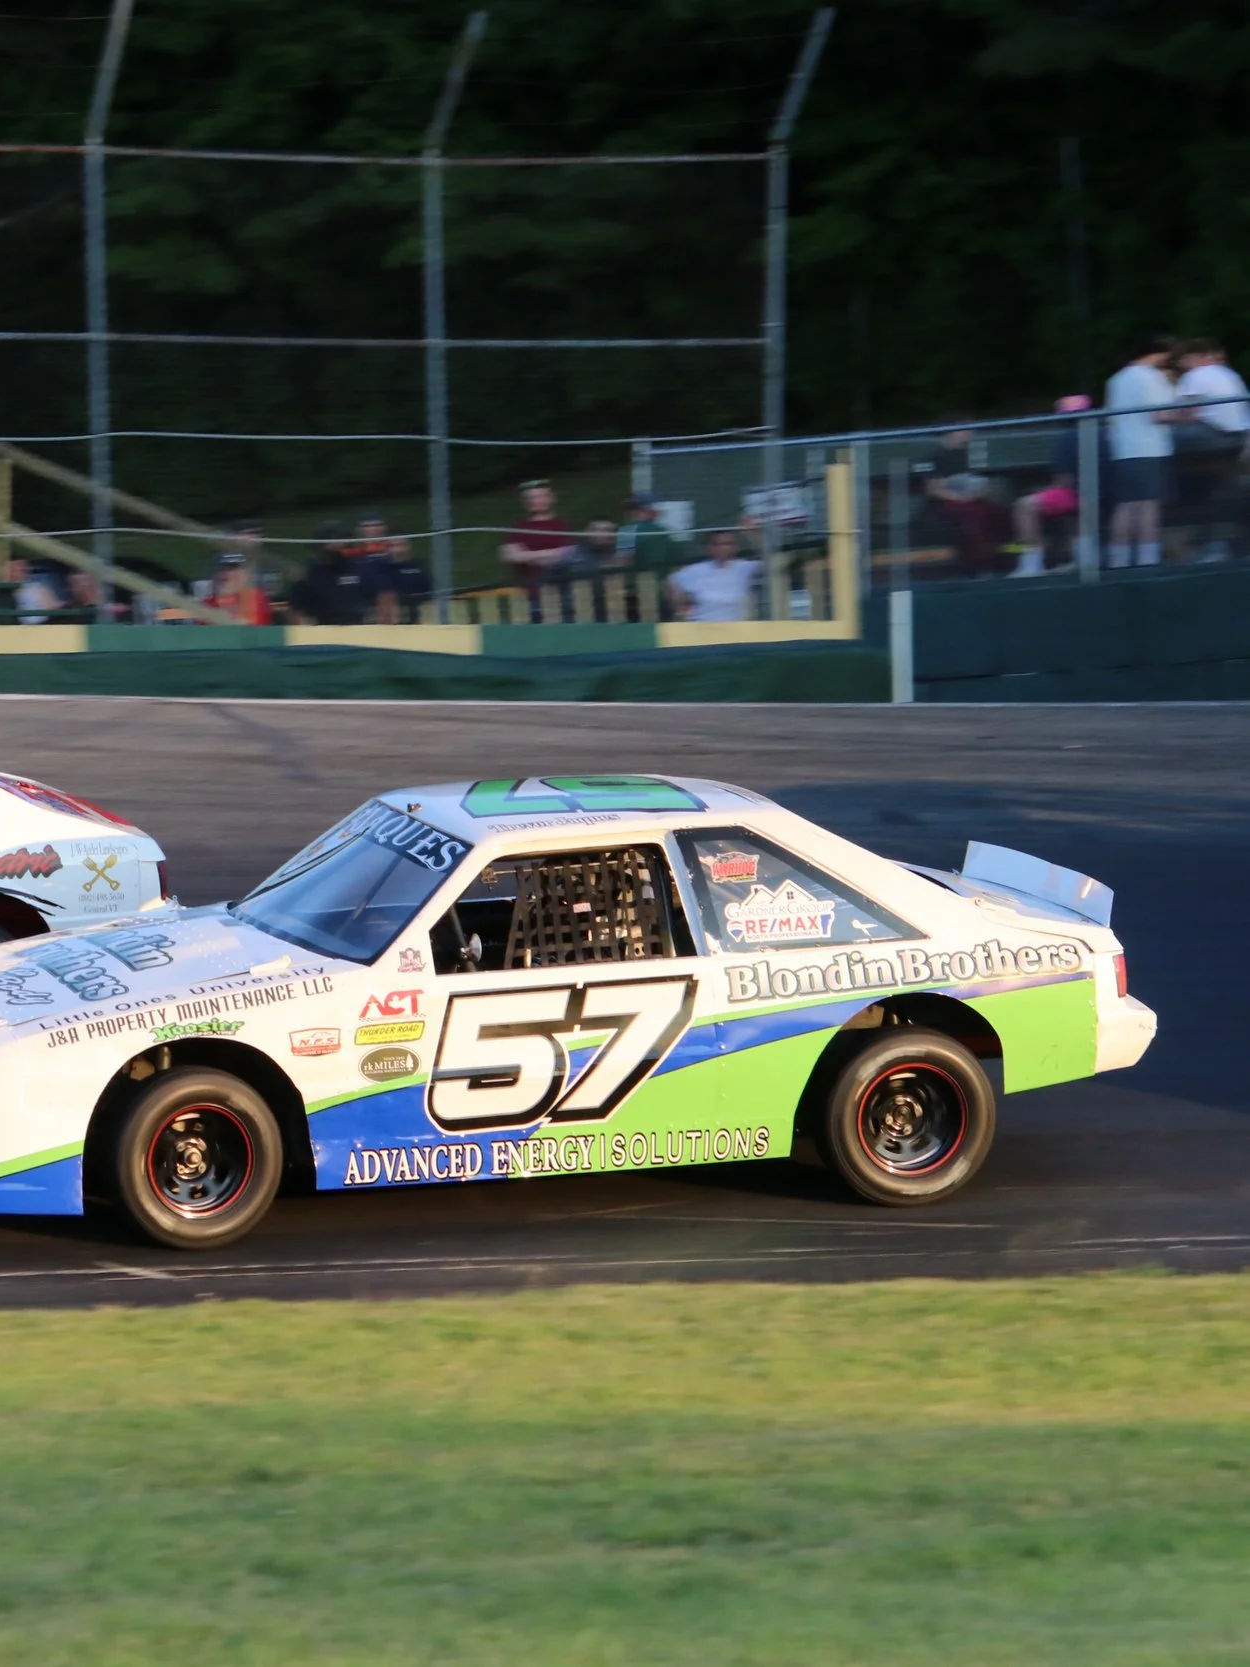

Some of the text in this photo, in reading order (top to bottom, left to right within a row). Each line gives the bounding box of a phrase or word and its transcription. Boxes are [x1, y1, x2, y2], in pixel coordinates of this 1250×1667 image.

[727, 900, 831, 918] GARDNER GROUP
[745, 915, 821, 935] RE/MAX
[726, 940, 1082, 1003] Blondin Brothers
[39, 965, 325, 1030] Little Ones University
[47, 975, 334, 1049] J&A PROPERTY MAINTENANCE LLC
[359, 988, 425, 1019] ACT
[149, 1016, 245, 1043] Hoosier
[359, 1024, 419, 1036] THUNDER ROAD
[364, 1059, 406, 1071] rk MILES
[425, 974, 699, 1138] 57
[343, 1125, 771, 1186] ADVANCED ENERGY SOLUTIONS
